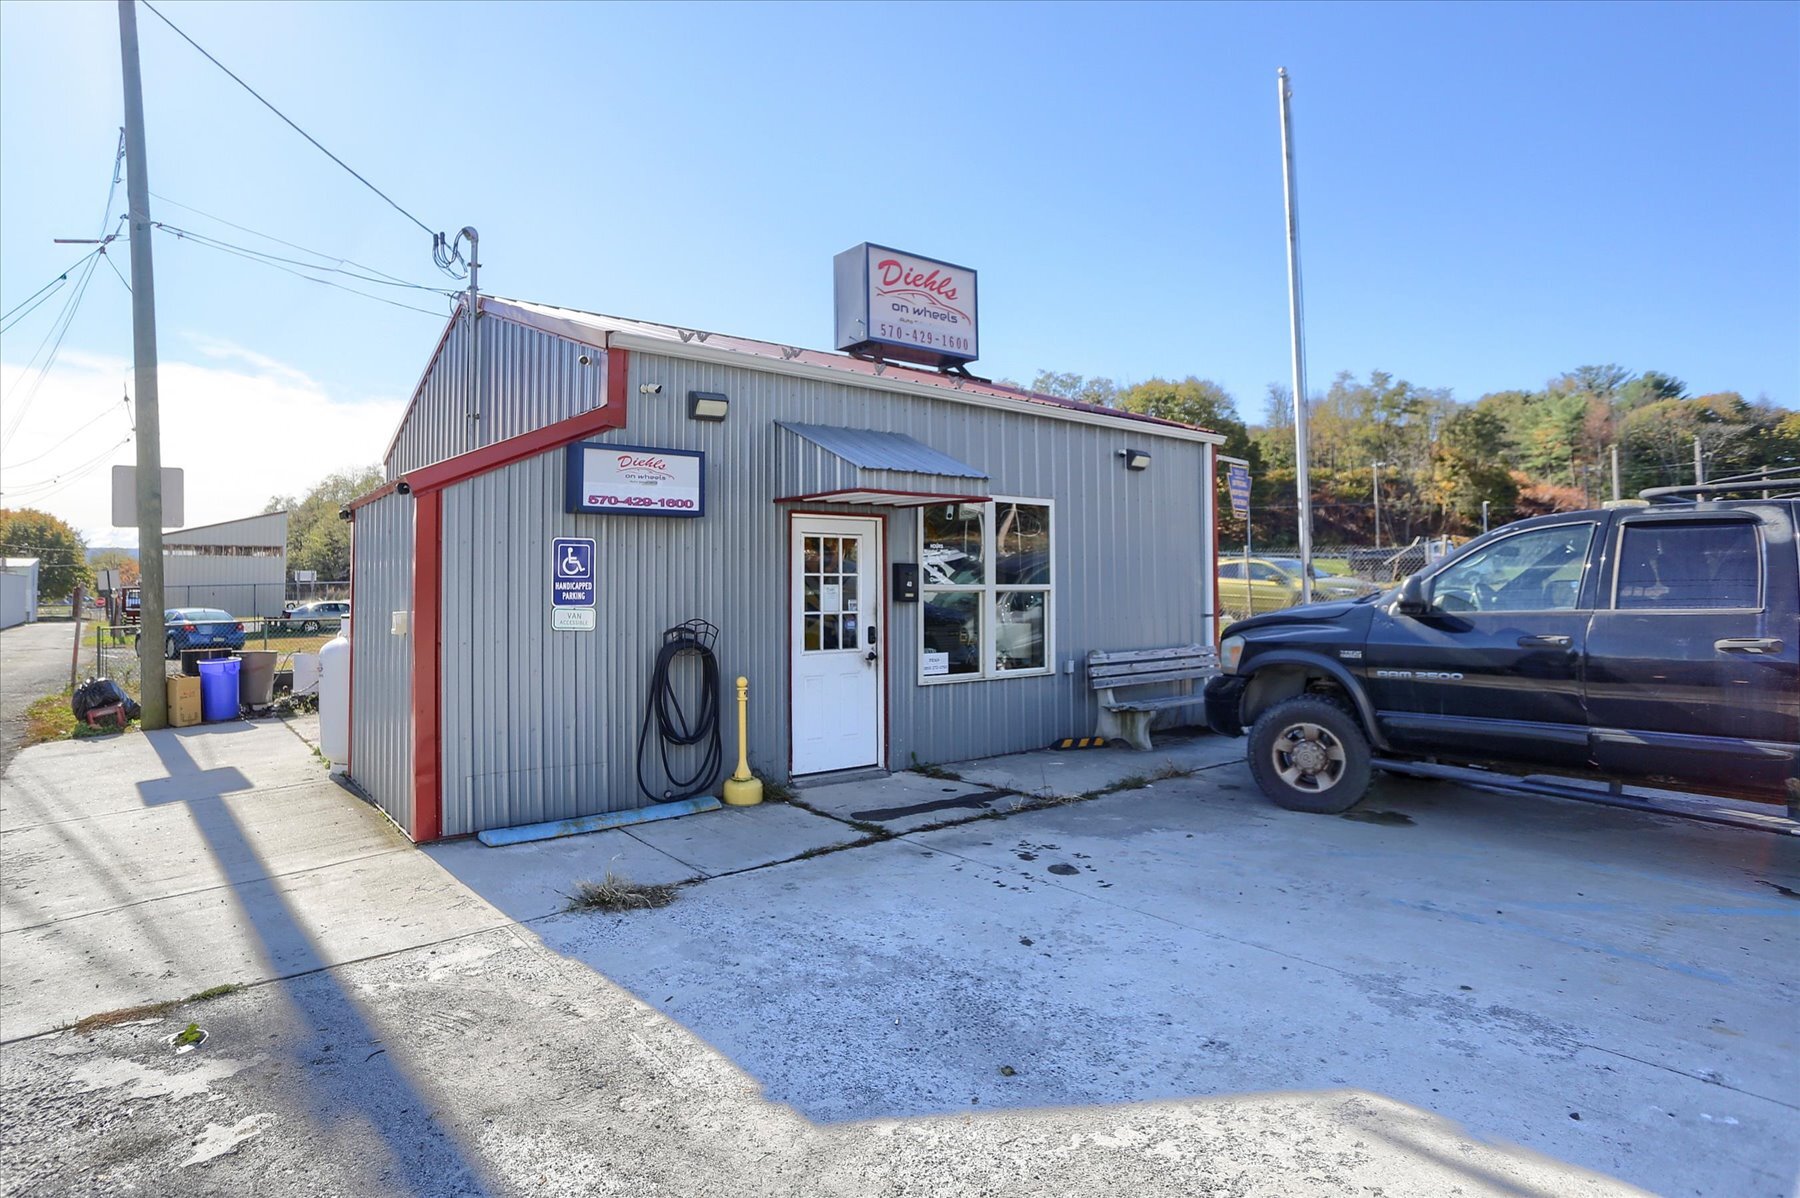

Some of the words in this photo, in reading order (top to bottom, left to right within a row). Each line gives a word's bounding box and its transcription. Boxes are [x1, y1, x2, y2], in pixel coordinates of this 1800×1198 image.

[878, 259, 958, 301] Diehls
[891, 303, 909, 314] on
[912, 306, 958, 324] wheels
[880, 323, 969, 351] 570-429-1600
[617, 455, 666, 470] Diehls
[638, 473, 666, 481] wheels
[588, 495, 694, 509] 570-429-1600
[555, 581, 592, 591] HANDICAPPED
[562, 591, 586, 601] PARKING
[567, 612, 582, 620] VAN
[1415, 671, 1464, 681] 2500
